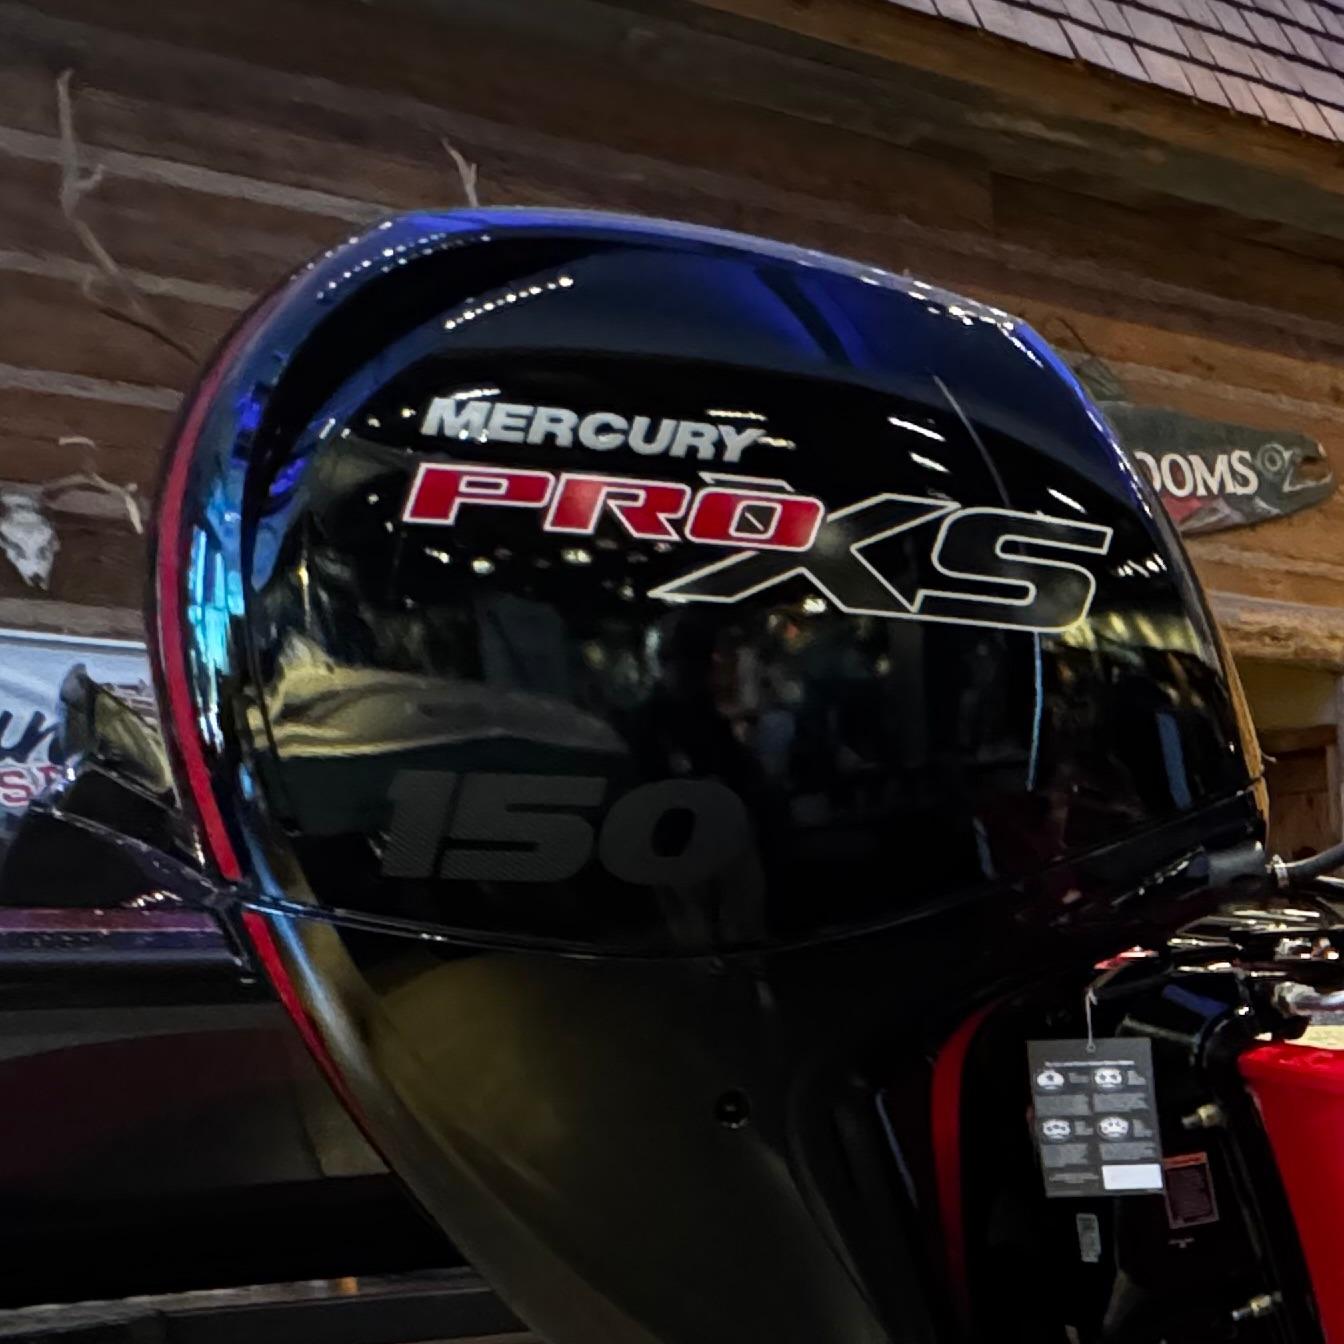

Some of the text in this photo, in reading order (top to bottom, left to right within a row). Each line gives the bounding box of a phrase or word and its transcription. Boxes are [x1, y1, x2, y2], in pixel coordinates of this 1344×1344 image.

[421, 397, 762, 462] MERCURY
[403, 463, 1114, 633] PRO XS
[379, 771, 752, 886] 150
